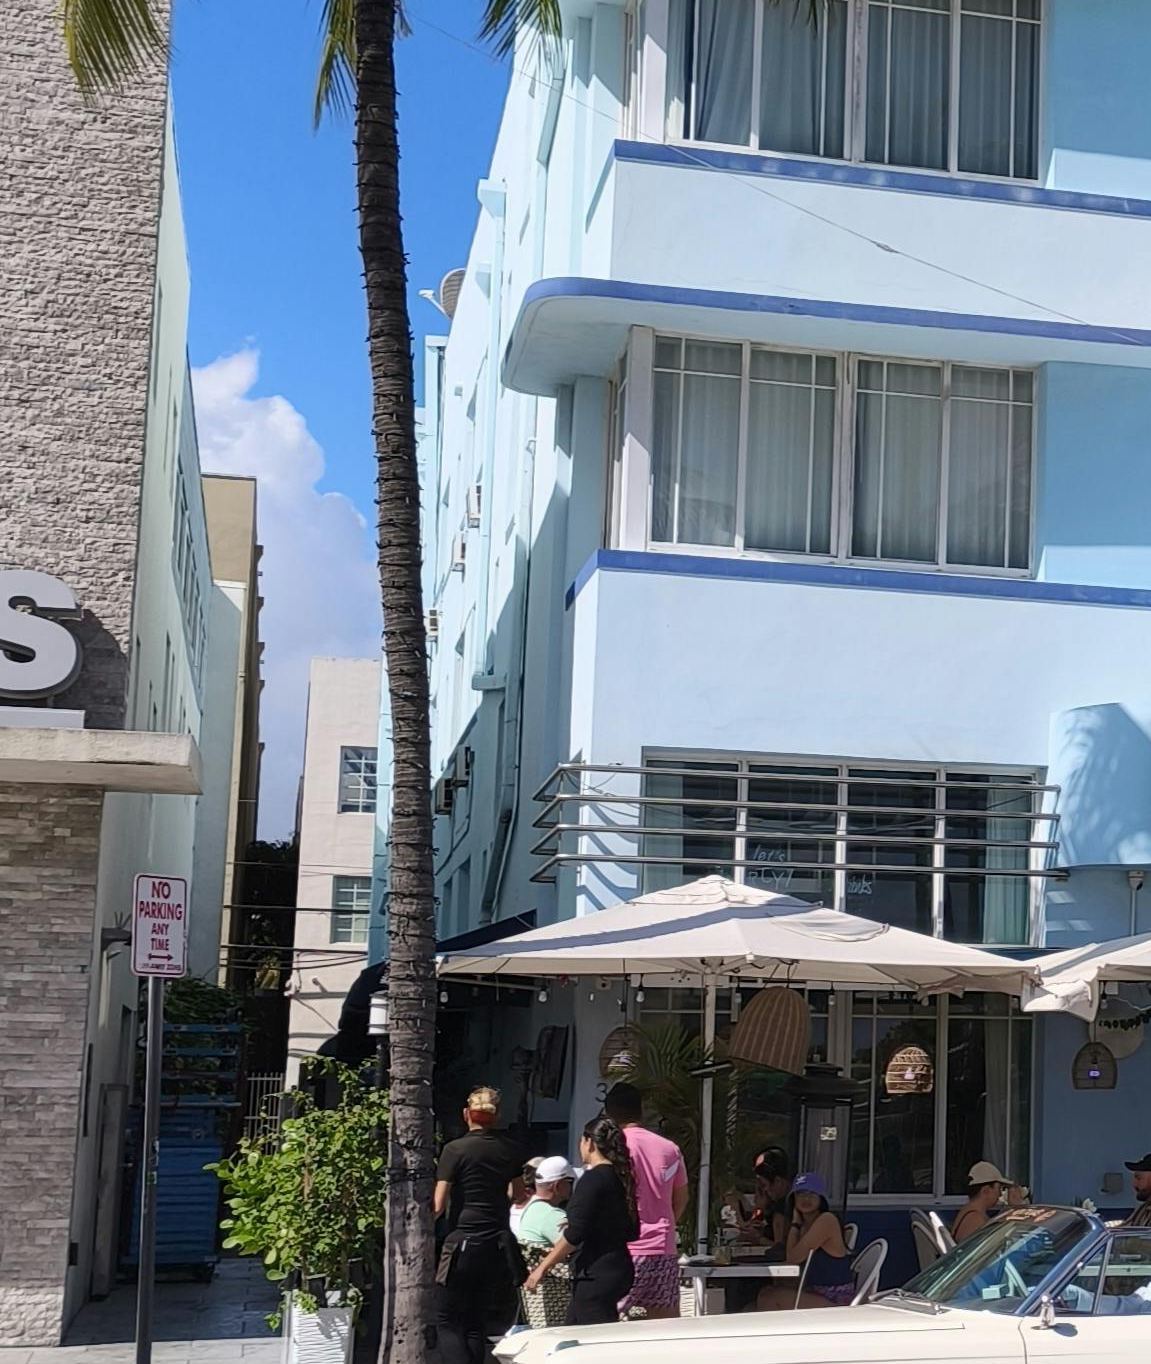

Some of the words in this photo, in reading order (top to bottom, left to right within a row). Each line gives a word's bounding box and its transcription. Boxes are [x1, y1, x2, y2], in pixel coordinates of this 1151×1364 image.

[151, 881, 171, 899] NO
[139, 901, 182, 920] PARKING
[151, 923, 169, 936] ANY
[151, 938, 169, 951] TIME
